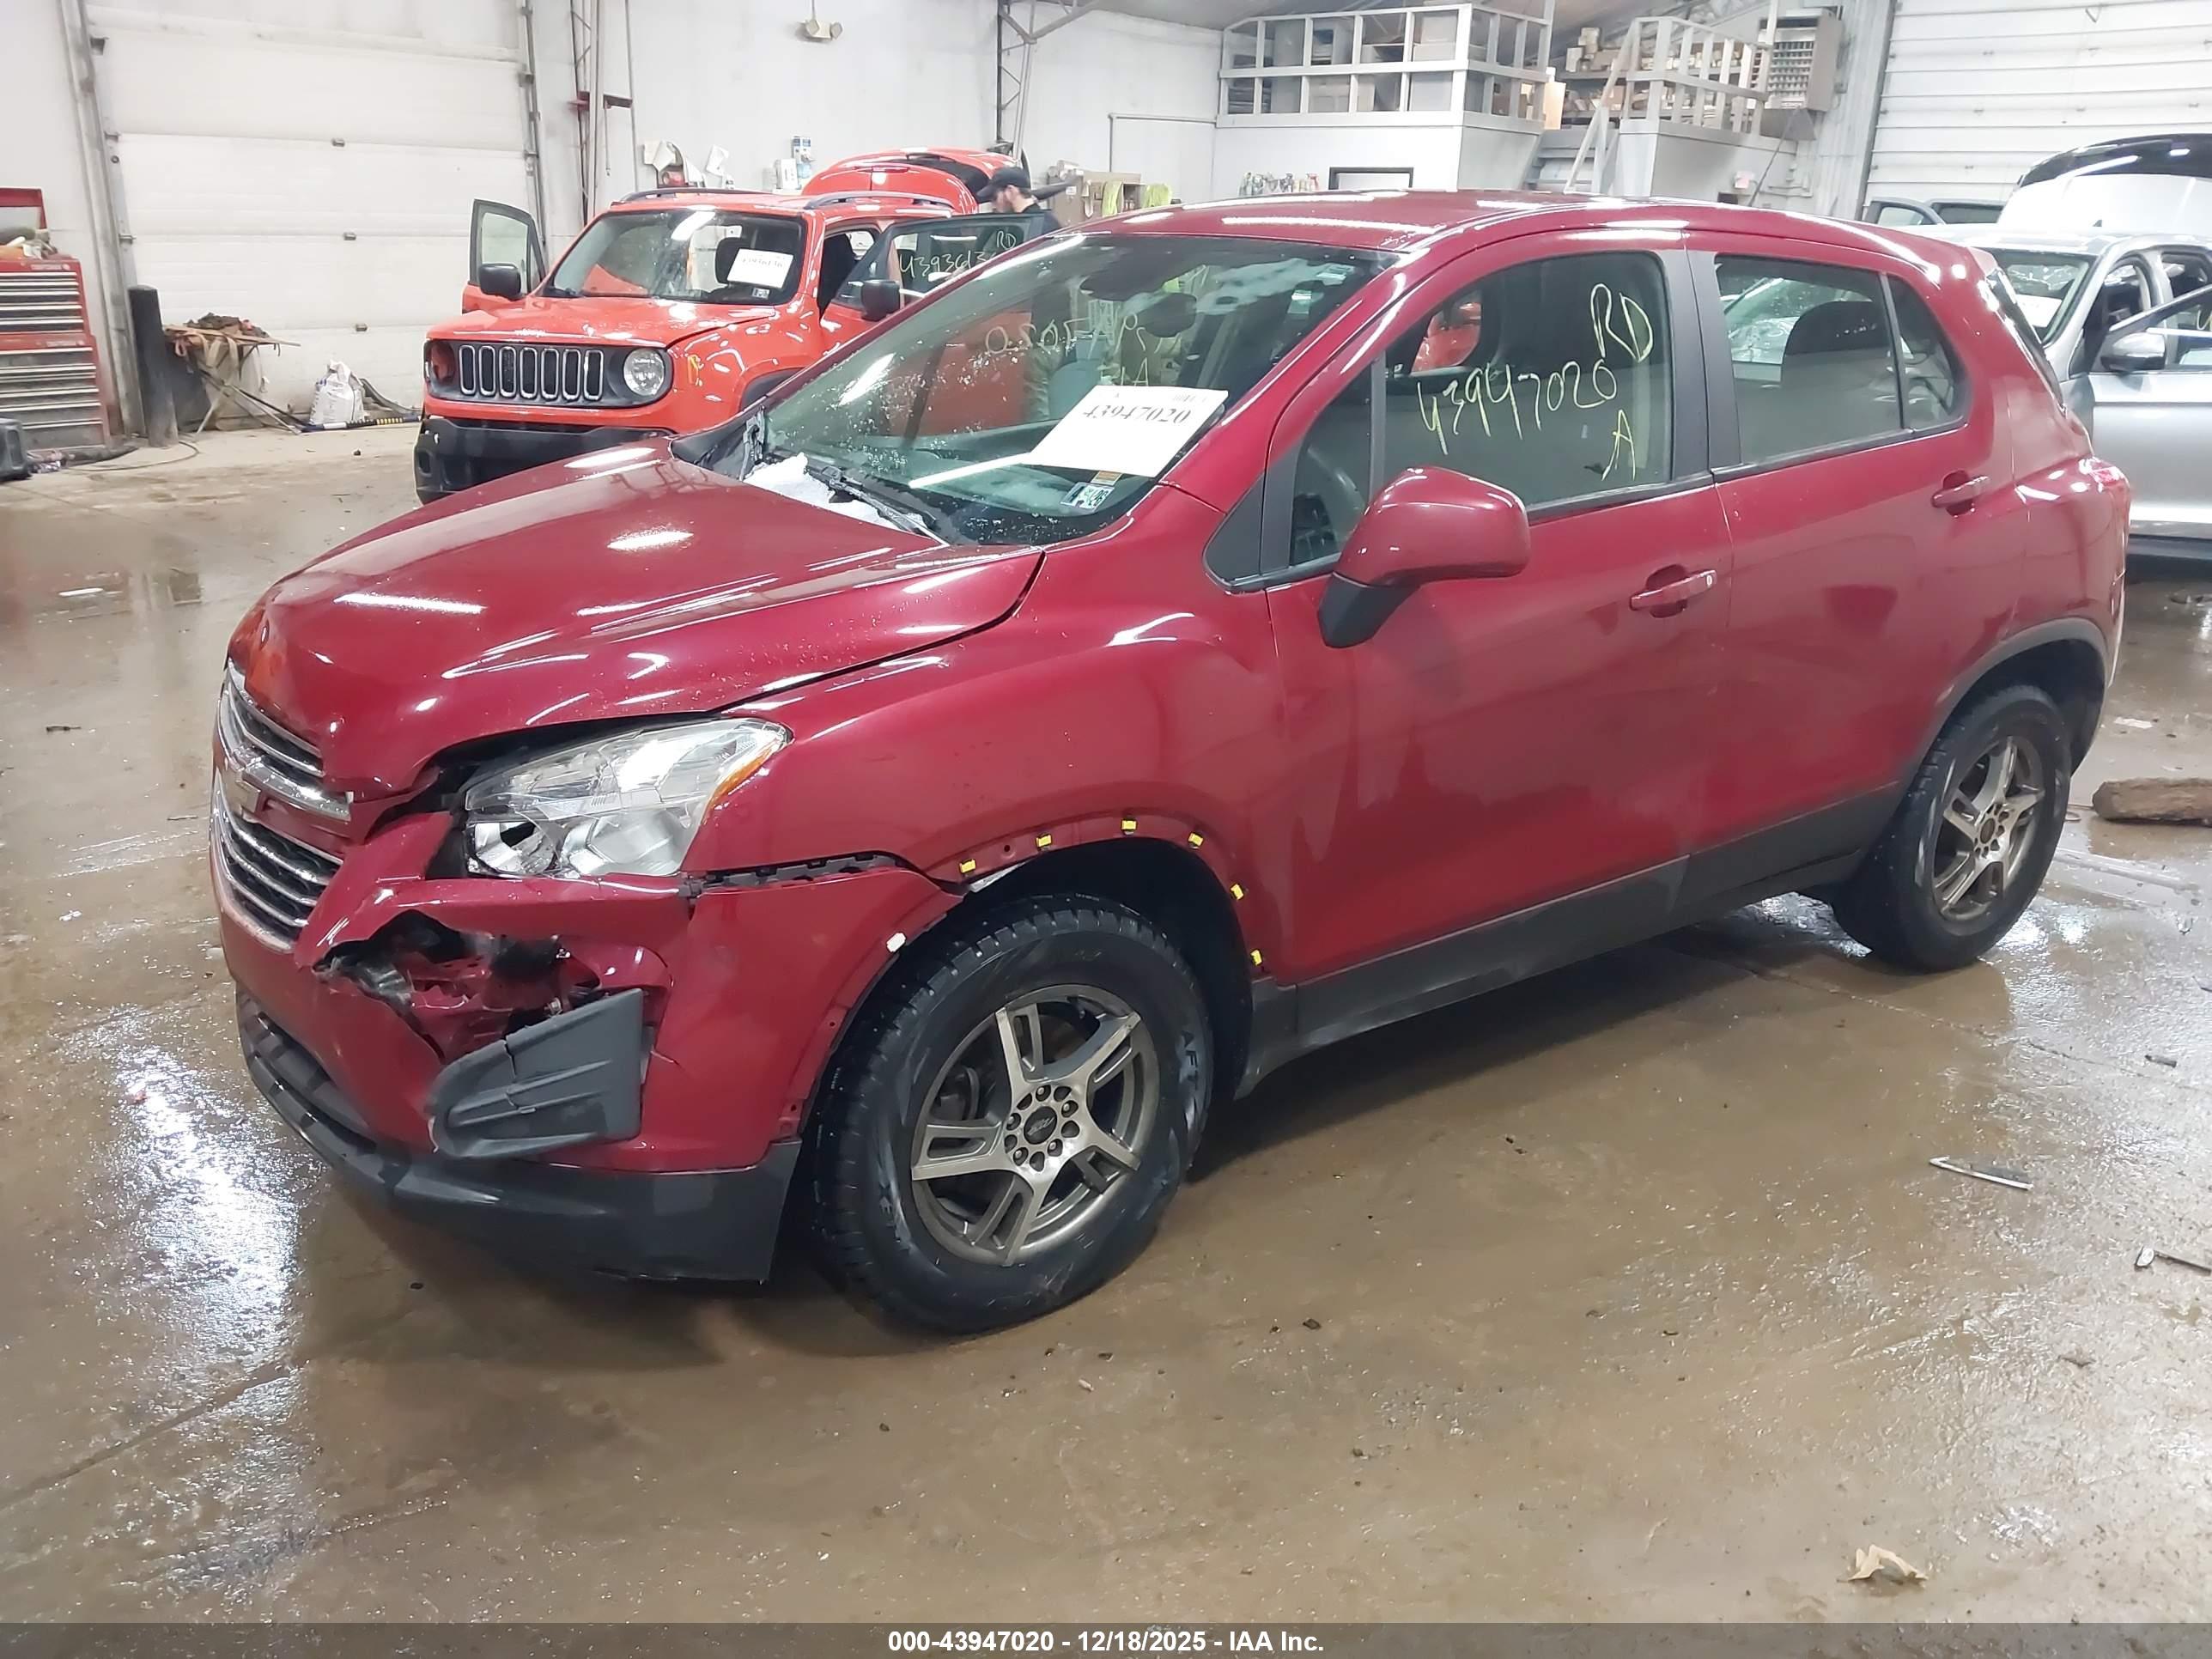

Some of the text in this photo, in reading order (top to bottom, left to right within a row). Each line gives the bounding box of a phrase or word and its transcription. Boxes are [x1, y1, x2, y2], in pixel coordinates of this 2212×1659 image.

[996, 230, 1017, 250] RD
[1590, 283, 1654, 363] RD
[1417, 358, 1618, 456] 43947020
[1601, 409, 1637, 482] A
